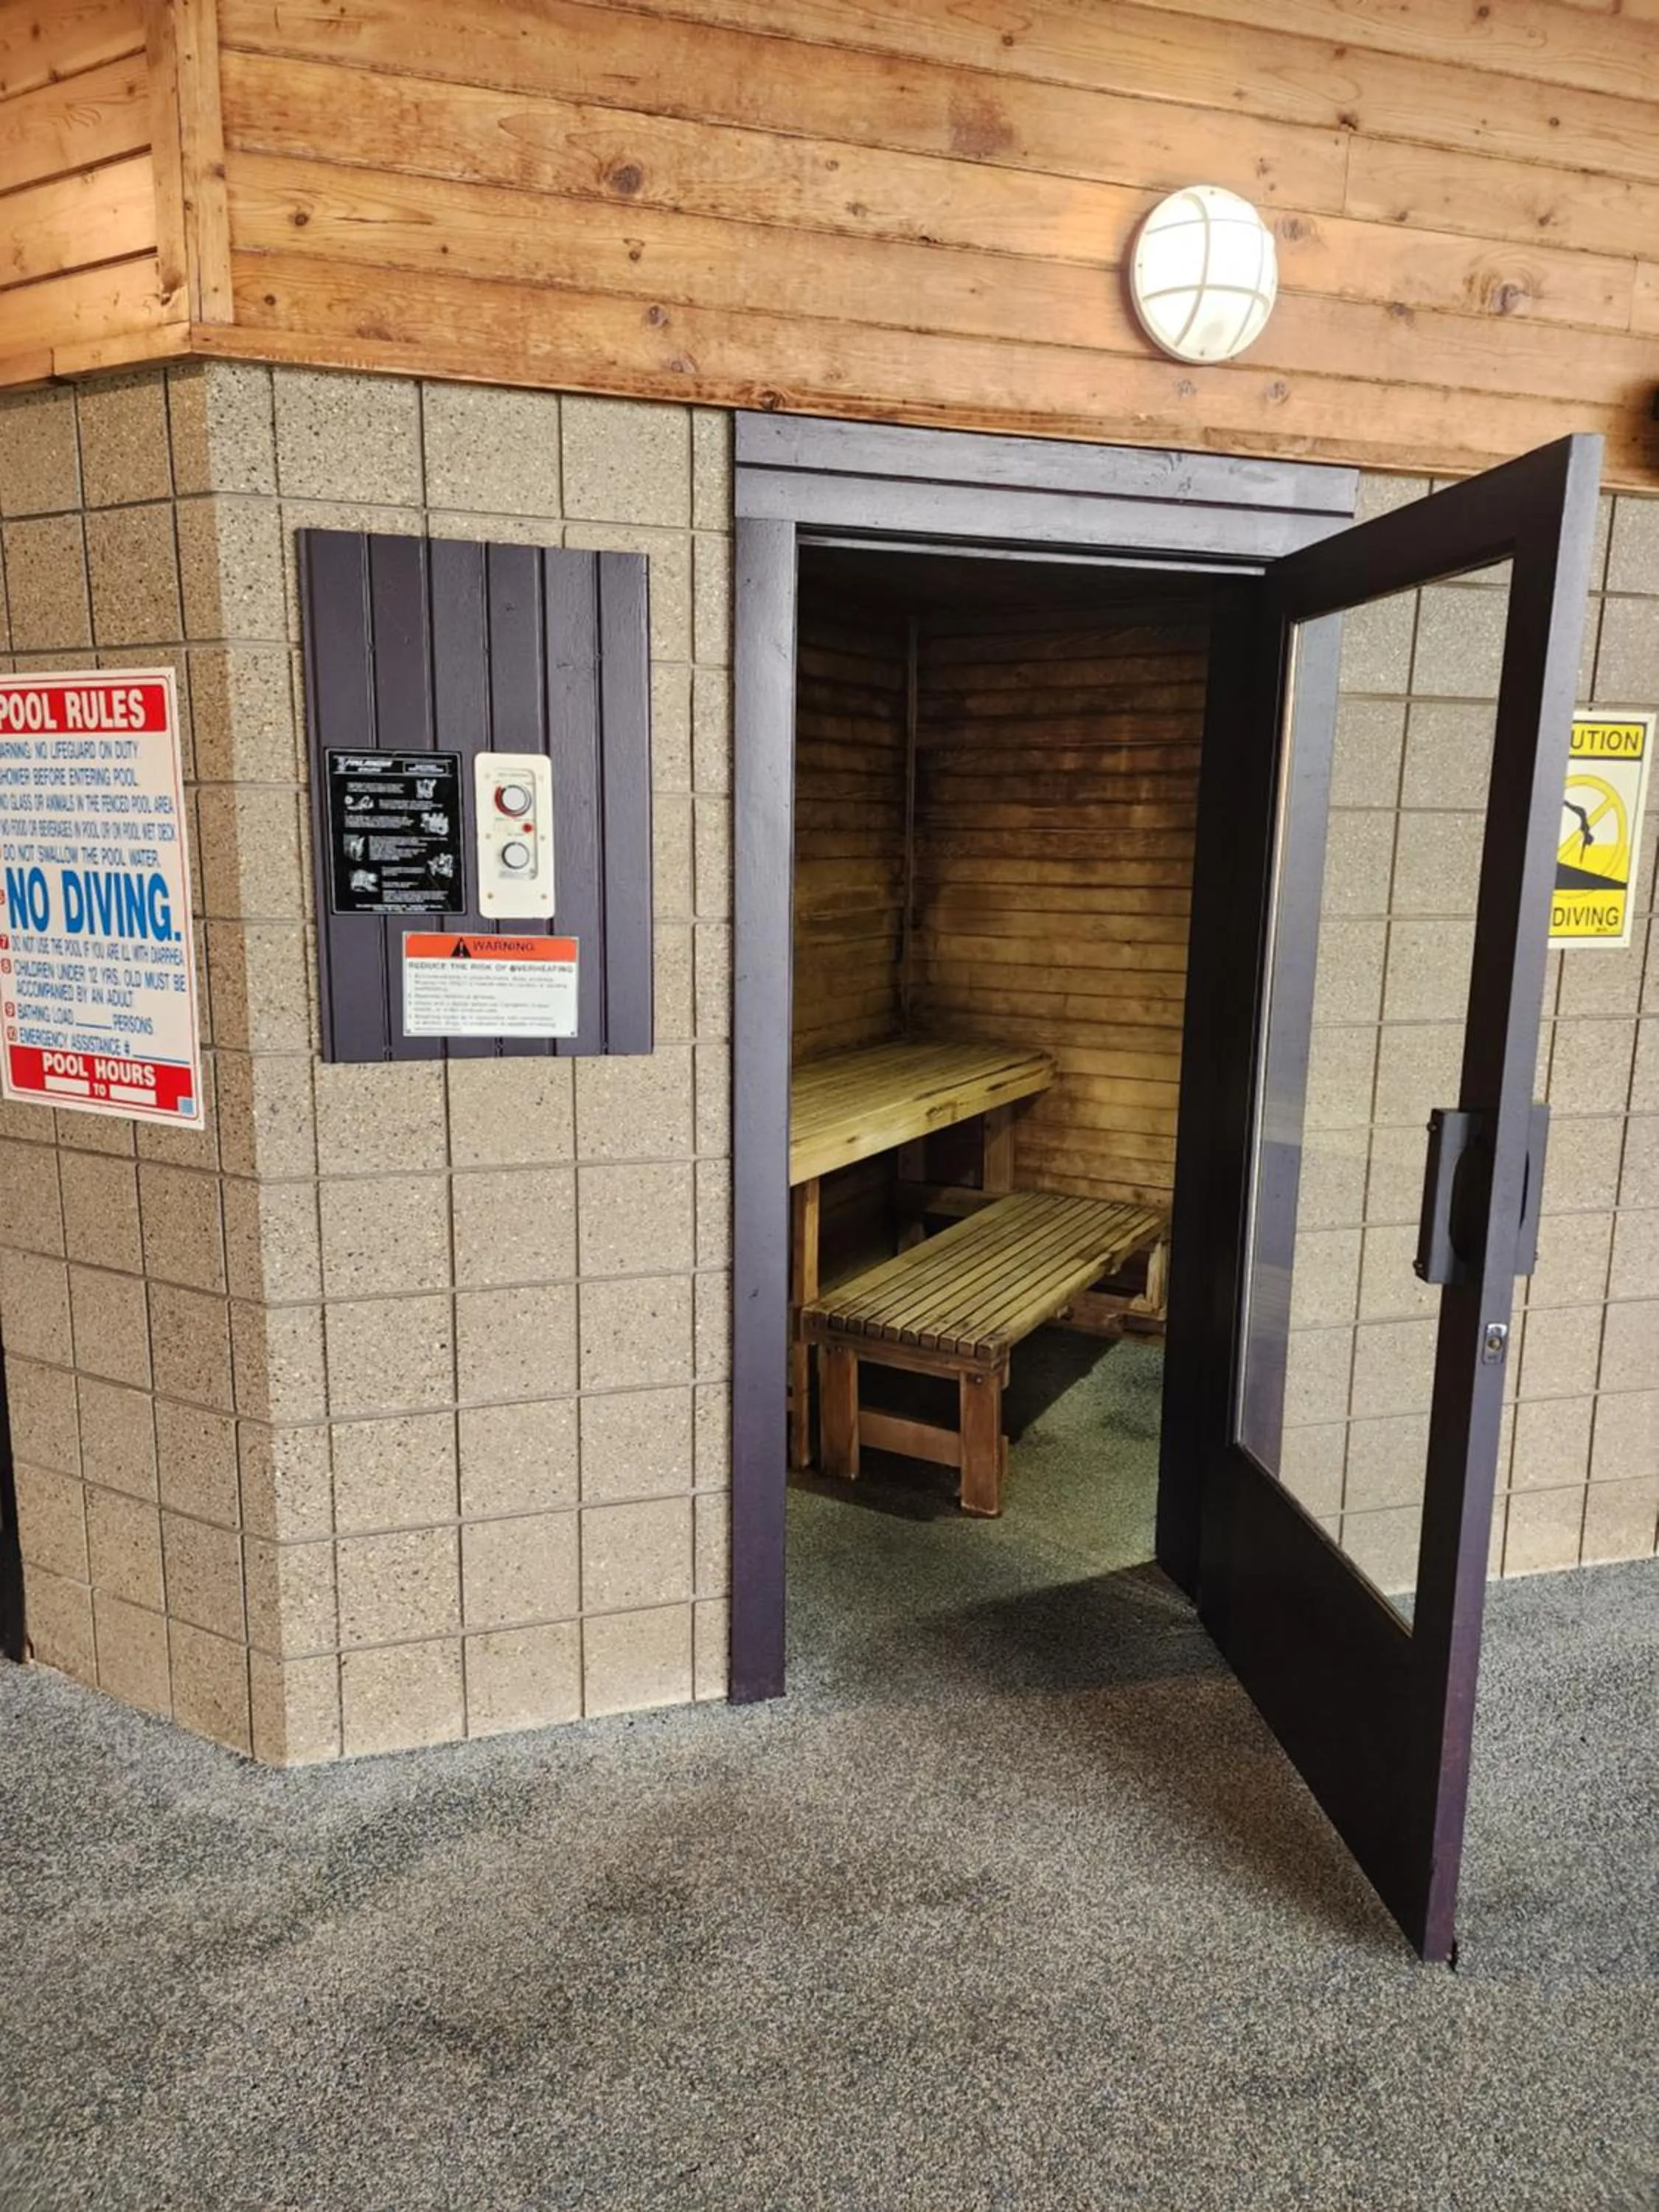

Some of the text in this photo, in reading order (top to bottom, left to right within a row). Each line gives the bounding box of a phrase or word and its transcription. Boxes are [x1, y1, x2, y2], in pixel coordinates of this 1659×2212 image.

[0, 689, 147, 731] POOL RULES
[35, 741, 47, 759] NO
[51, 740, 95, 759] LIFEGUARD
[98, 740, 112, 759] ON
[1570, 730, 1639, 751] UTION
[0, 768, 29, 785] HOWER
[32, 768, 66, 786] BEFORE
[69, 768, 111, 786] ENTERING
[10, 794, 32, 811] GLASS
[34, 794, 44, 811] OR
[46, 794, 74, 812] ANIMALS
[76, 795, 84, 812] IN
[85, 794, 100, 812] THE
[101, 794, 129, 813] FENCED
[131, 795, 152, 813] POOL
[11, 819, 27, 836] FOOD
[29, 819, 37, 836] OR
[38, 820, 73, 838] BEVERAGES
[74, 821, 81, 838] IN
[82, 821, 100, 838] POOL
[102, 821, 111, 838] OR
[113, 821, 121, 839] ON
[122, 821, 141, 840] POOL
[142, 823, 156, 840] WET
[4, 844, 15, 861] DO
[17, 844, 35, 862] NOT
[38, 845, 77, 864] SWALLOW
[80, 846, 99, 865] THE
[101, 847, 126, 866] POOL
[5, 867, 182, 942] NO DIVING.
[1552, 906, 1619, 927] DIVING
[12, 934, 20, 951] DO
[22, 936, 35, 953] NOT
[37, 936, 49, 954] USE
[51, 937, 63, 956] THE
[65, 939, 83, 958] POOL
[84, 940, 89, 957] IF
[91, 942, 105, 959] YOU
[106, 942, 119, 960] ARE
[121, 943, 131, 961] ILL
[133, 945, 148, 963] WITH
[473, 940, 535, 952] WARNING
[14, 959, 55, 979] CHILDREN
[57, 963, 86, 982] UNDER
[88, 966, 98, 983] 12
[123, 969, 142, 987] OLD
[145, 970, 170, 990] MUST
[173, 973, 186, 992] BE
[408, 961, 445, 970] REDUCE
[509, 964, 573, 973] OVERHEATING
[16, 979, 74, 1001] ACCOMPANIED
[77, 985, 88, 1004] BY
[91, 987, 104, 1005] AN
[18, 1003, 51, 1023] BATHING
[52, 1007, 74, 1026] LOAD
[112, 1013, 153, 1036] PERSONS
[19, 1026, 69, 1048] EMERGENCY
[71, 1033, 121, 1056] ASSISTANCE
[42, 1051, 156, 1088] POOL HOURS
[93, 1083, 107, 1097] TO
